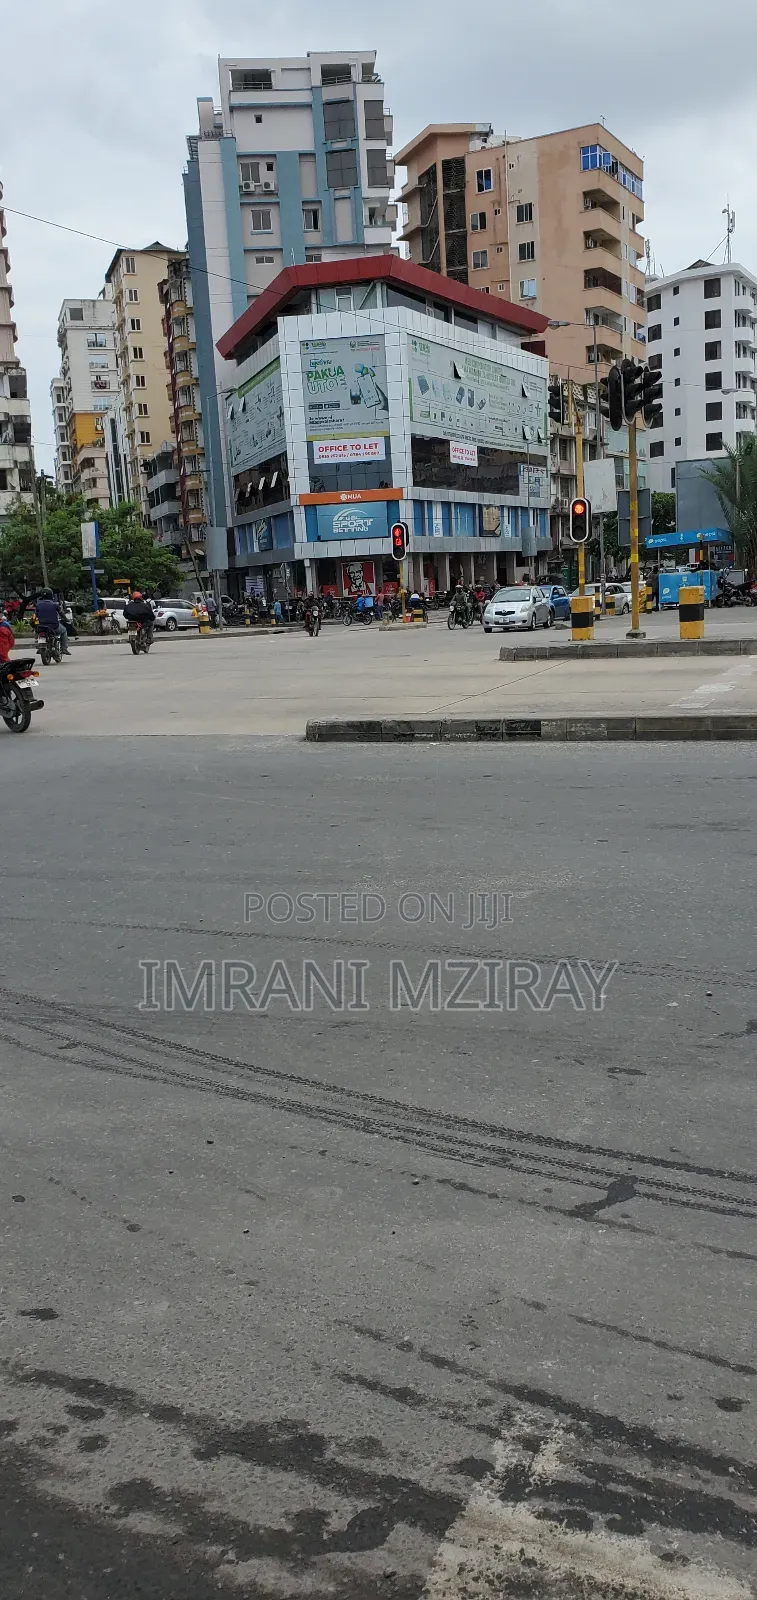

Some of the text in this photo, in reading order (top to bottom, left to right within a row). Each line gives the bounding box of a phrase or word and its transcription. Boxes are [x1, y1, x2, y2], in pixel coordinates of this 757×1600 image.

[306, 366, 345, 382] PAKUA
[318, 445, 348, 453] OFFICE
[333, 518, 374, 528] SPORT
